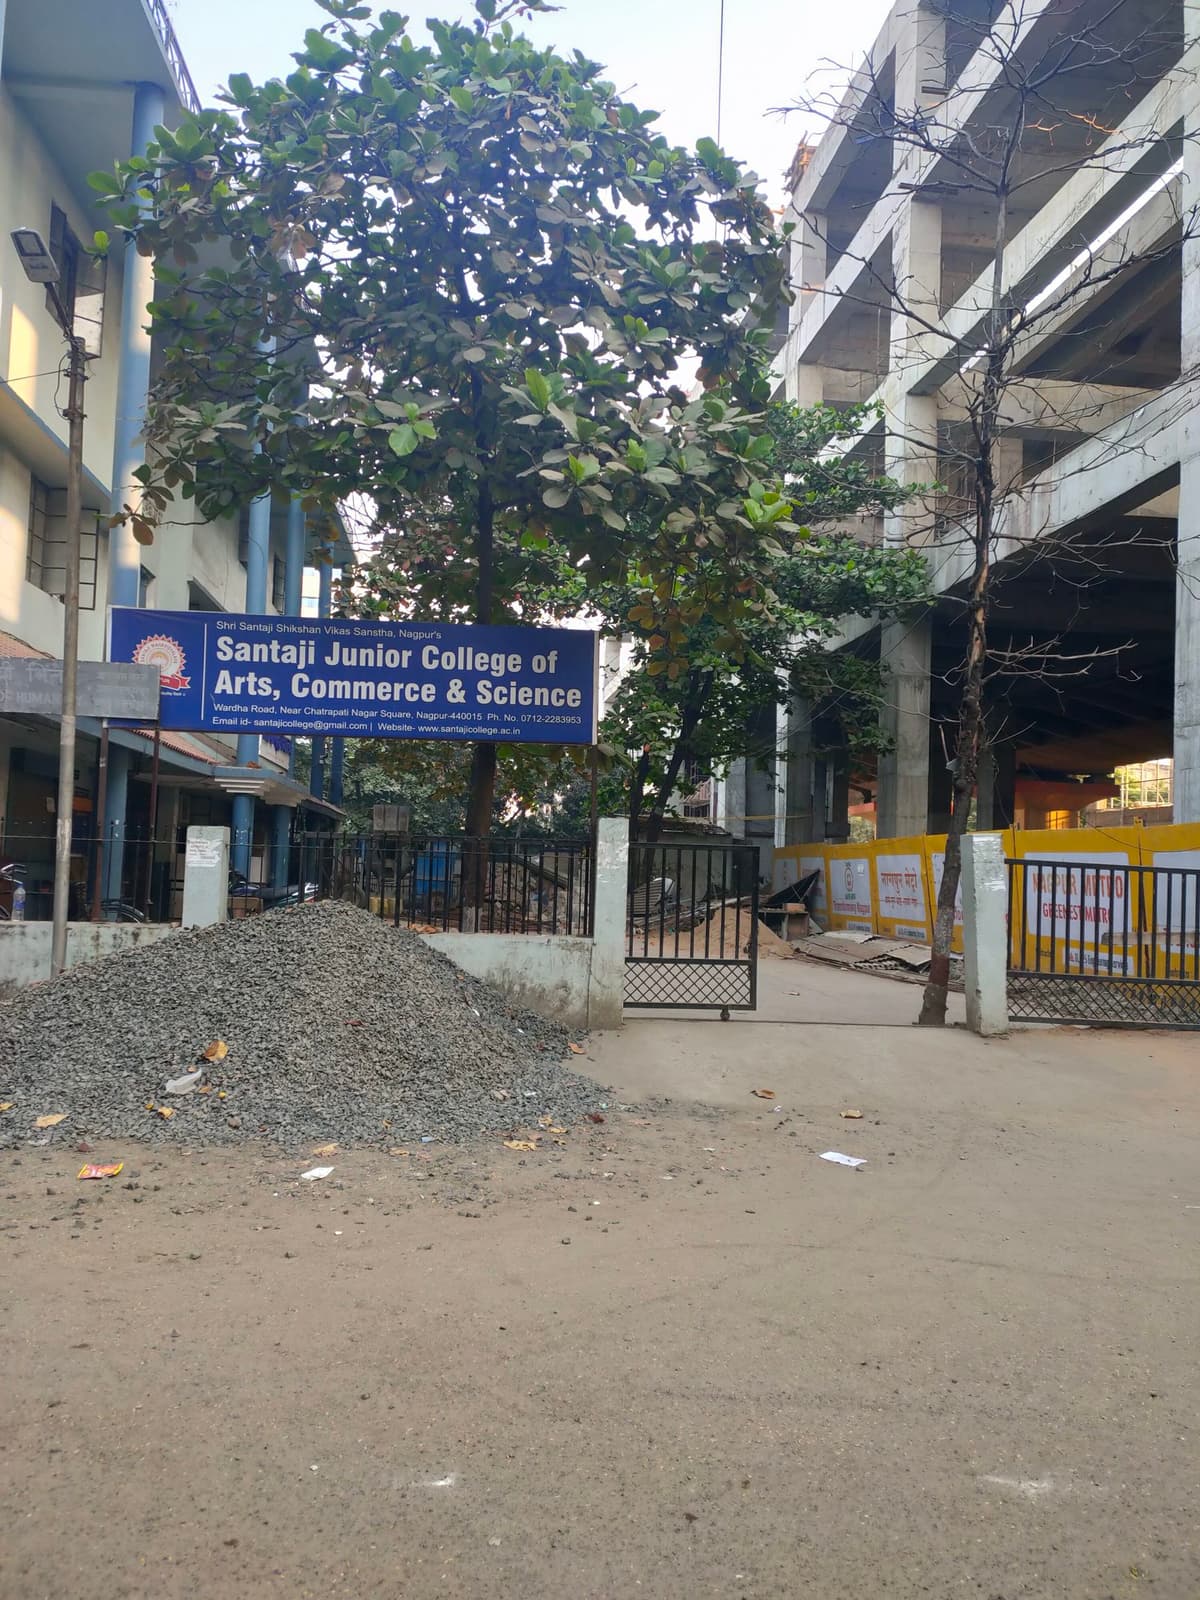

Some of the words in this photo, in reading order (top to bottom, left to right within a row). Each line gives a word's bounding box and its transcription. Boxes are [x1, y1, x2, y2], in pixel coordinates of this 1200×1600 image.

[216, 620, 236, 631] Shri
[239, 621, 274, 633] Santaji
[276, 623, 321, 634] Shikshan
[323, 625, 351, 636] Vikas
[353, 627, 396, 638] Sanstha,
[399, 628, 442, 641] Nagpur's
[216, 635, 316, 670] Santaji
[324, 641, 413, 669] Junior
[421, 645, 522, 678] College
[532, 649, 559, 674] of
[214, 669, 281, 701] Arts,
[291, 672, 437, 703] Commerce
[446, 678, 467, 704] &
[476, 679, 582, 708] Science
[213, 703, 249, 713] Wardha
[251, 704, 277, 714] Road,
[280, 706, 302, 715] Near
[304, 707, 349, 719] Chatrapati
[351, 709, 378, 719] Nagar
[380, 710, 414, 721] Square,
[416, 711, 483, 722] Nagpur-440015
[487, 713, 502, 721] Ph.
[504, 714, 519, 722] No.
[521, 714, 582, 724] 0712-2283953
[212, 716, 238, 725] Email
[240, 717, 252, 726] id-
[253, 718, 368, 731] santajicollege@gmail.com
[377, 722, 416, 732] Website-
[418, 726, 521, 736] www.santajicollege.ac.in
